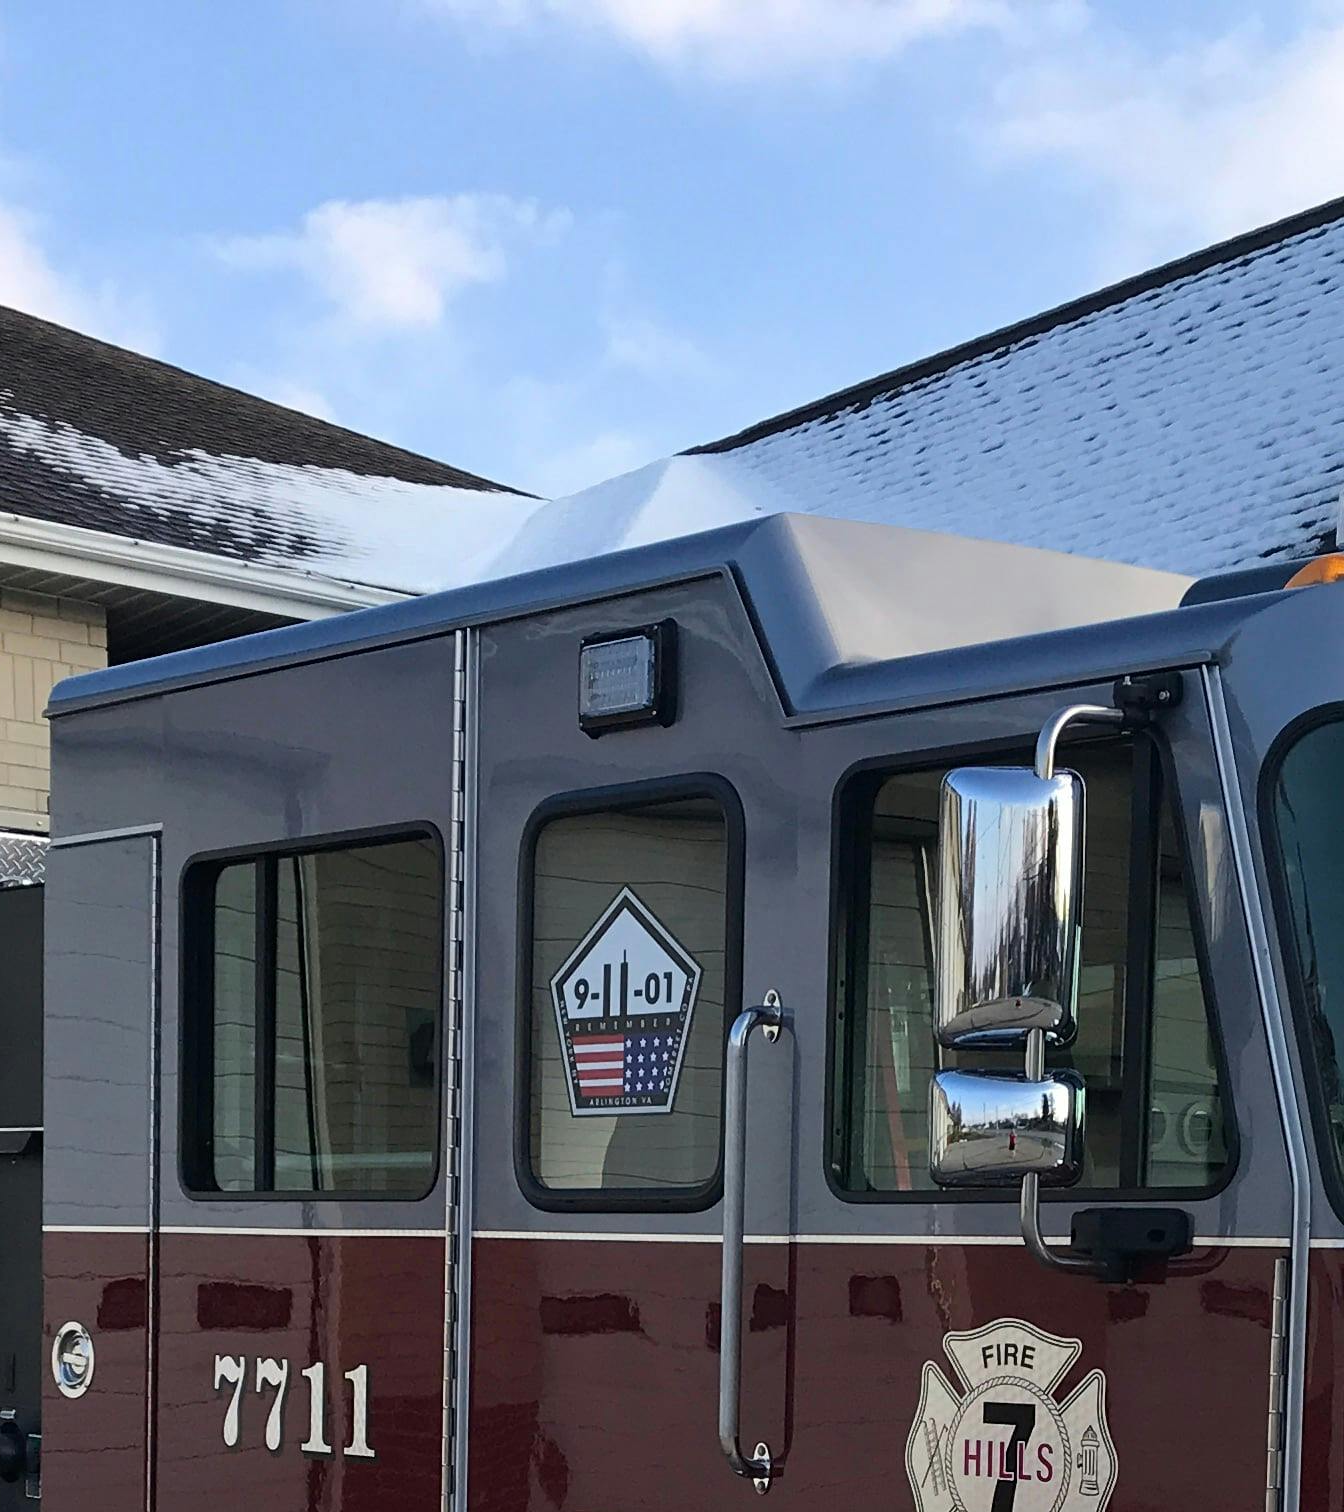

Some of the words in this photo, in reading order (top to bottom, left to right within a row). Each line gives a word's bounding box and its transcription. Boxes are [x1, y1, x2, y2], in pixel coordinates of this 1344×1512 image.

[981, 1342, 1036, 1369] FIRE
[214, 1354, 375, 1458] 7711
[963, 1439, 1053, 1483] HILLS
